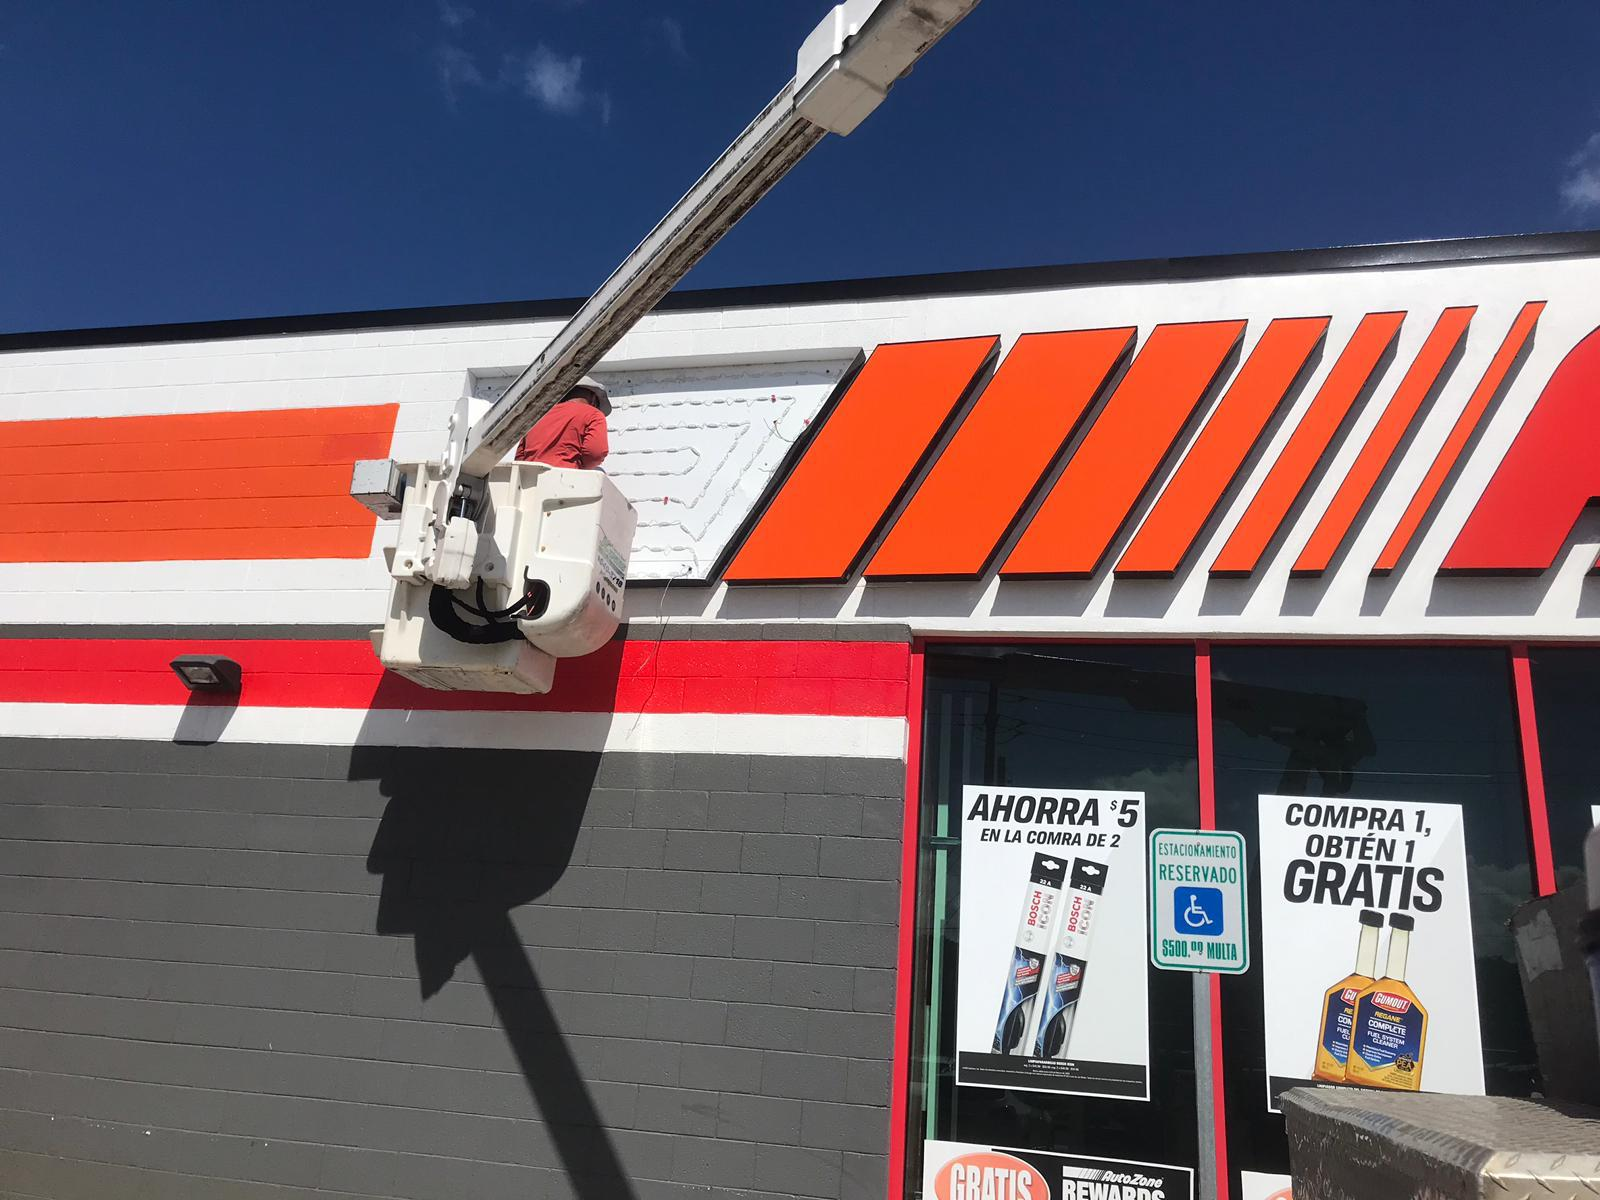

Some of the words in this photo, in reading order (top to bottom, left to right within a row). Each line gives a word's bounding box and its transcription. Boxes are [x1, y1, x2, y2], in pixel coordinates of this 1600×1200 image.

[967, 794, 1099, 826] AHORRA
[1110, 799, 1140, 828] $5
[1285, 803, 1405, 832] COMPRA
[1415, 810, 1431, 837] 1,
[980, 828, 1000, 842] EN
[1004, 830, 1021, 843] LA
[1027, 831, 1081, 846] COMRA
[1086, 833, 1107, 847] DE
[1110, 834, 1121, 848] 2
[1305, 832, 1396, 862] OBTÉN
[1405, 840, 1415, 863] 1
[1158, 843, 1237, 858] ESTACIONAMIENTO
[1159, 864, 1237, 884] RESERVADO
[1283, 859, 1444, 912] GRATIS
[1027, 890, 1042, 926] BOSCH
[1067, 896, 1082, 932] BOSCH
[1207, 942, 1237, 960] MULTA
[1375, 992, 1409, 1010] GUMOUT
[1367, 1031, 1380, 1039] FUEL
[1382, 1034, 1405, 1045] SYSTEM
[1368, 1020, 1406, 1036] COMPLETE
[1372, 1037, 1398, 1049] CLEANER
[1101, 1170, 1163, 1188] AutoZone
